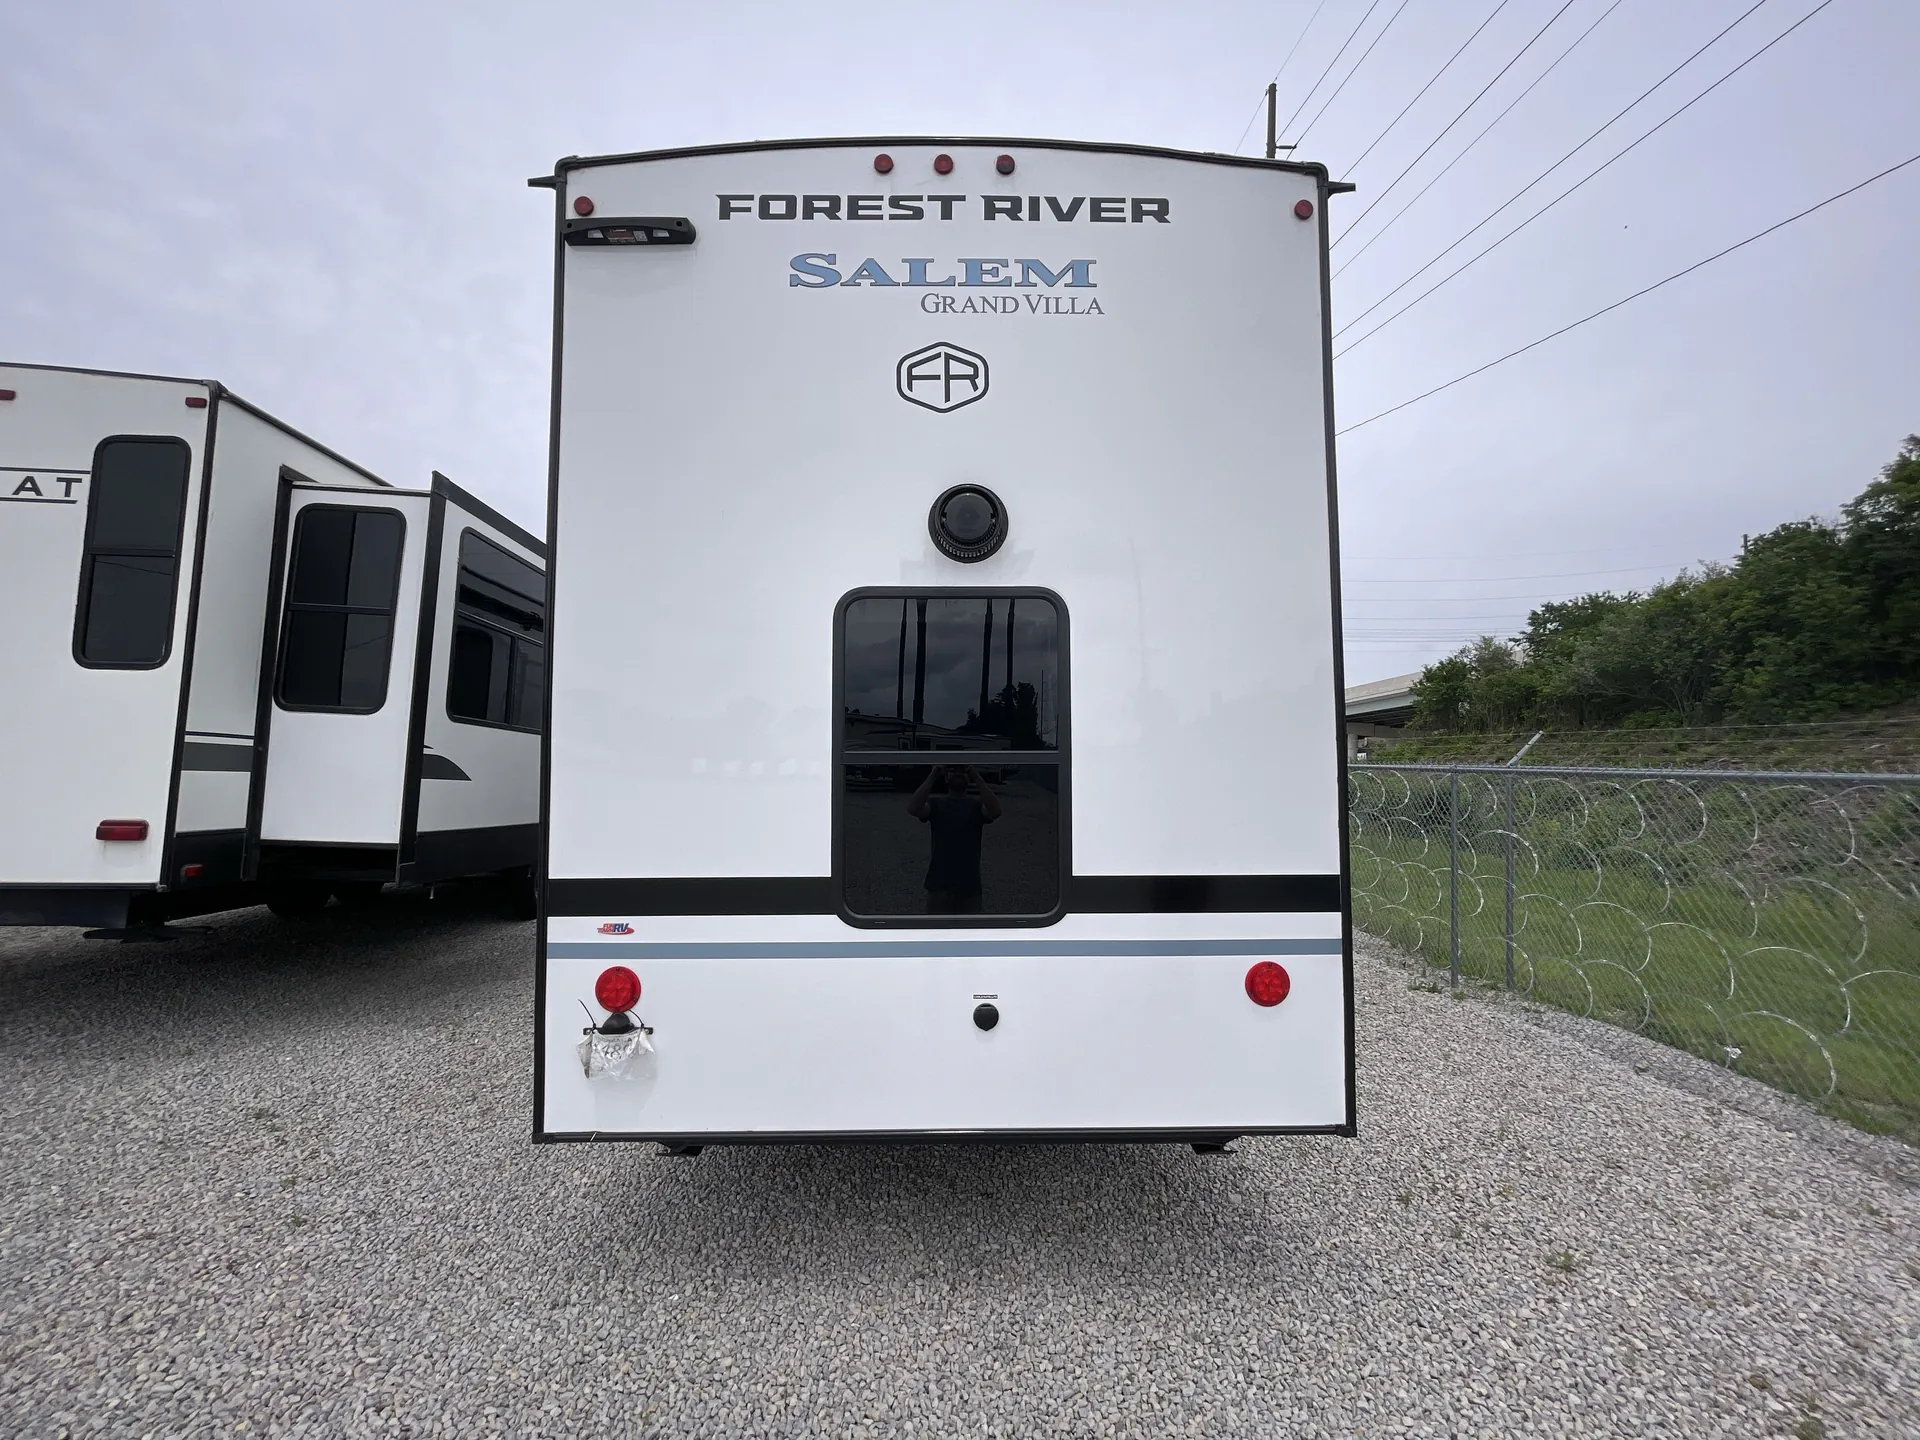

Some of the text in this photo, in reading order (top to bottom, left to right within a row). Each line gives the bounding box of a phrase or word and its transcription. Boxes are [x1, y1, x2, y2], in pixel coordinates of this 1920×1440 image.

[714, 194, 1172, 223] FOREST RIVER
[789, 253, 1098, 288] SALEM
[920, 292, 1106, 316] GRAND VILLA
